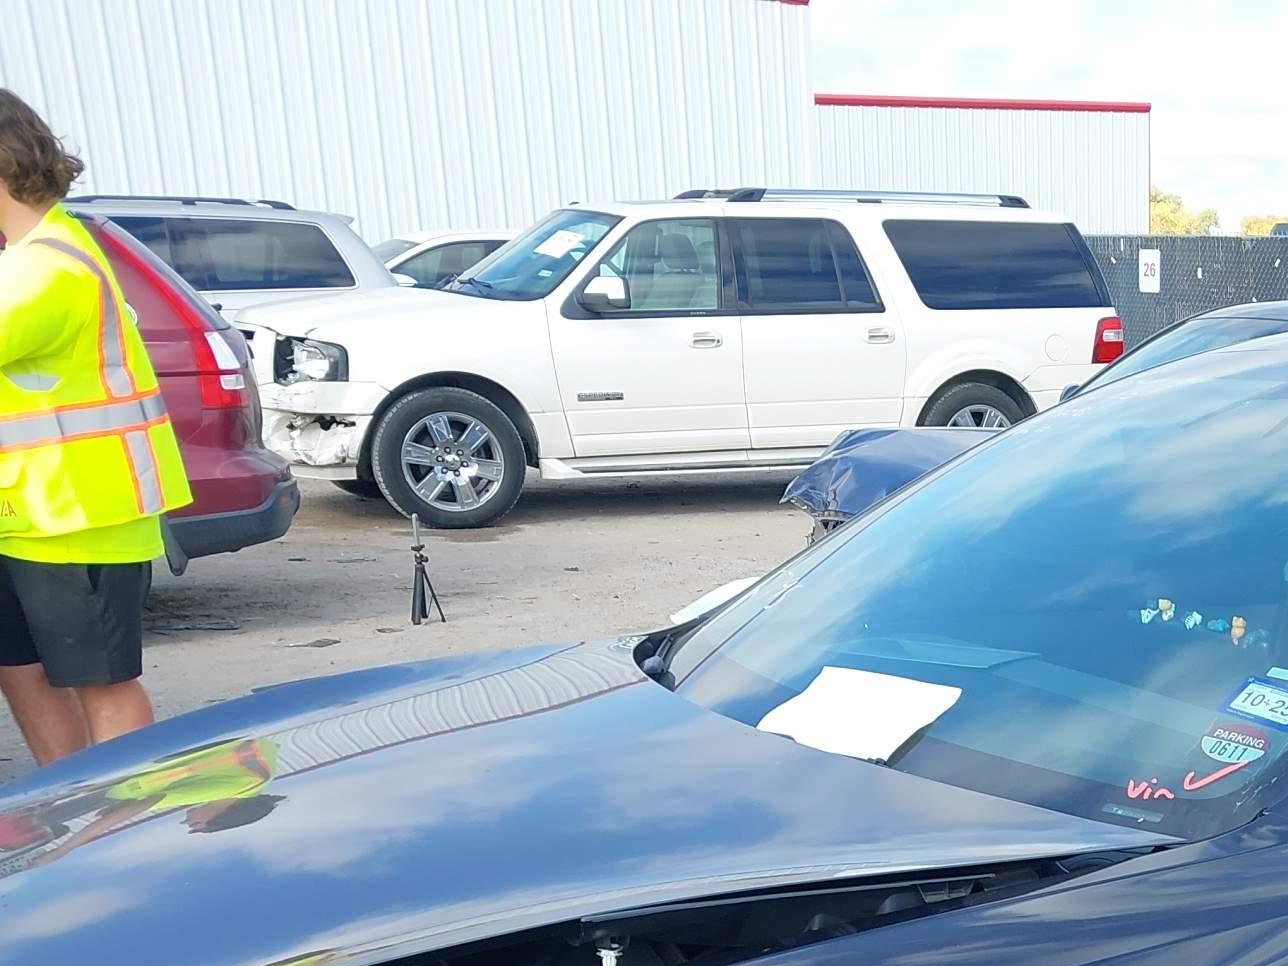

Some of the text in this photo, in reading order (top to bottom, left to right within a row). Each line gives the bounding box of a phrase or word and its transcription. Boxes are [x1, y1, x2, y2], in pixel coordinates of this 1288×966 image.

[1142, 262, 1157, 278] 26
[1212, 728, 1266, 750] PARKING
[1208, 740, 1249, 762] 0611
